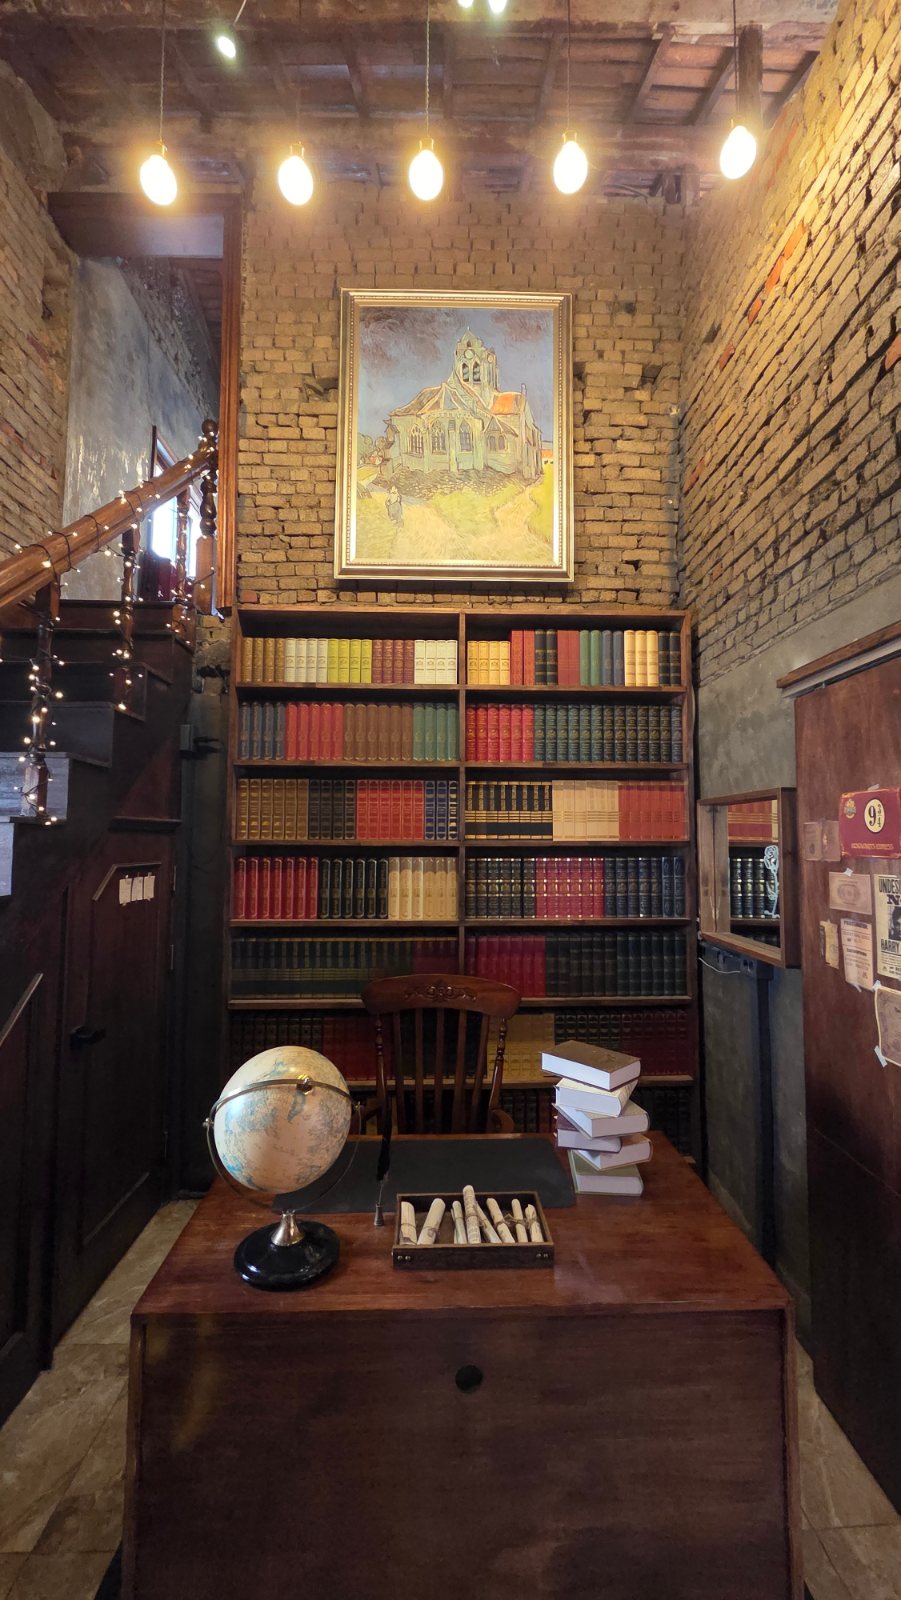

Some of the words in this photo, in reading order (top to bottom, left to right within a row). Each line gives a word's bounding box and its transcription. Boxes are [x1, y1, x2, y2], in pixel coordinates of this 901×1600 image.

[868, 805, 876, 827] 9
[886, 894, 901, 905] N
[880, 938, 900, 953] HARRY
